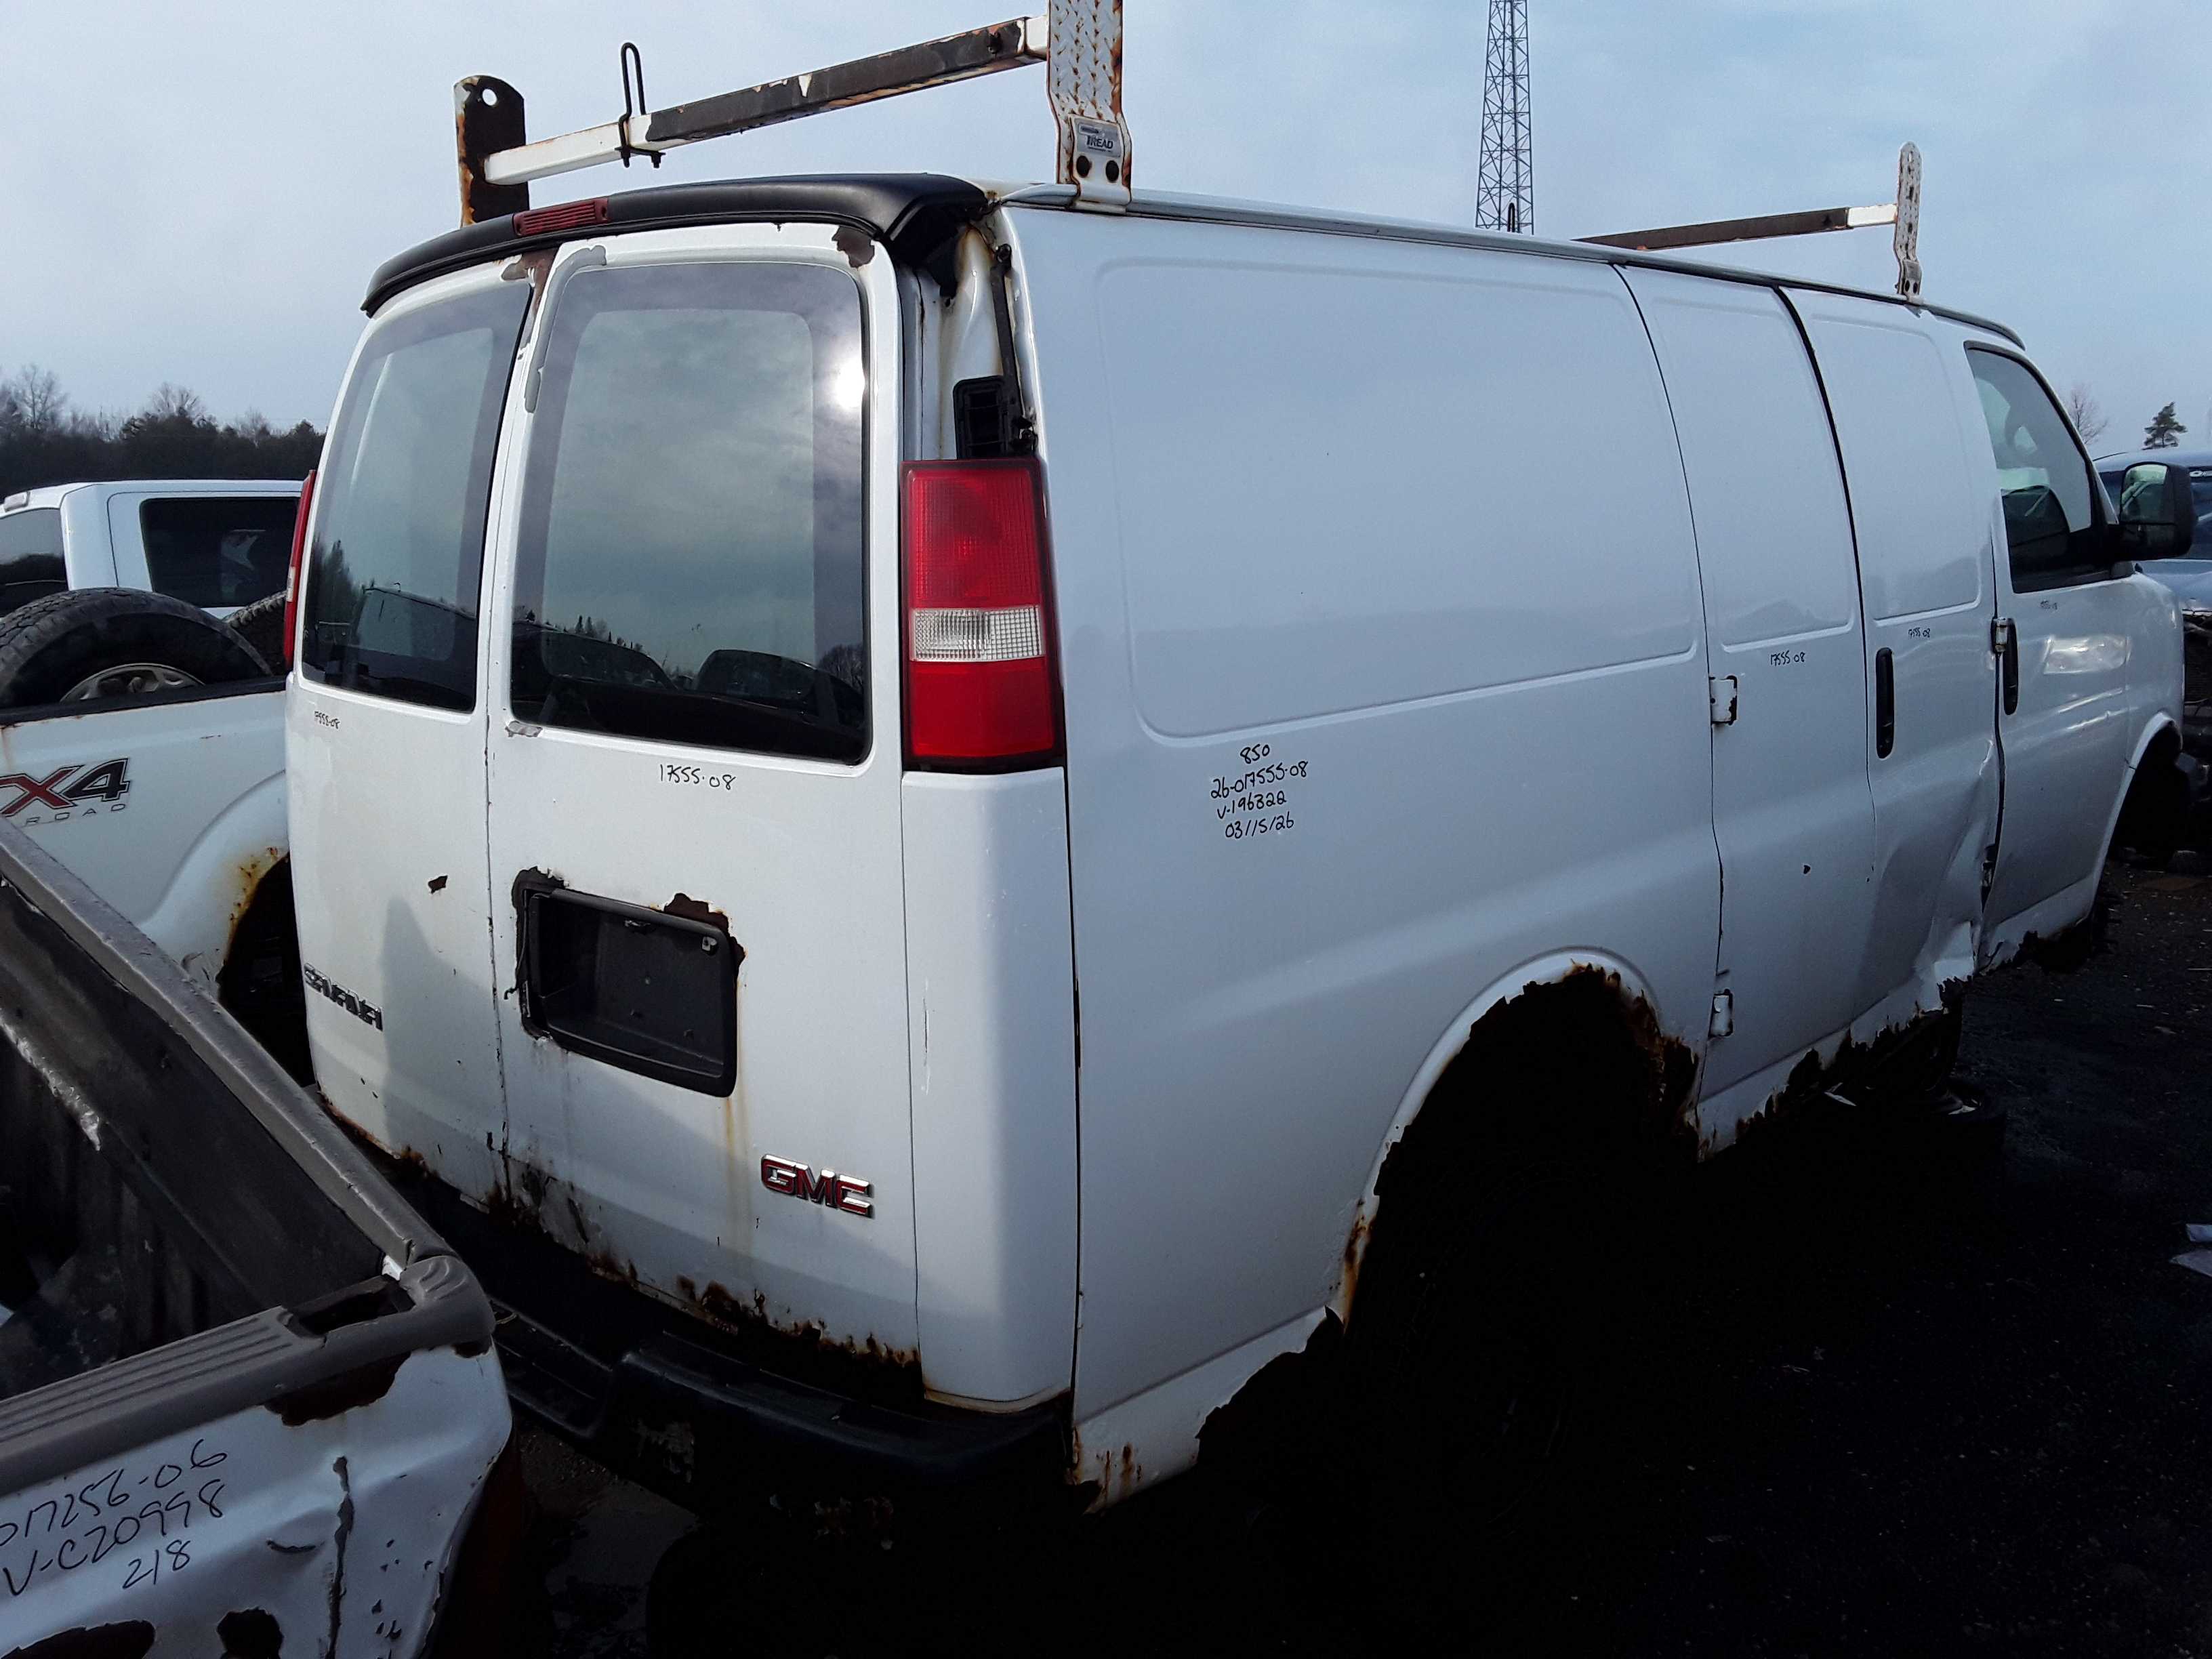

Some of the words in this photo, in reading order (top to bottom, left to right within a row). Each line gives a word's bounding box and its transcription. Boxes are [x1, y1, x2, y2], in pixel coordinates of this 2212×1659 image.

[1240, 743, 1271, 764] 850
[24, 803, 126, 825] ROAD
[1225, 811, 1294, 839] 03/15/26
[760, 1153, 876, 1219] GMC
